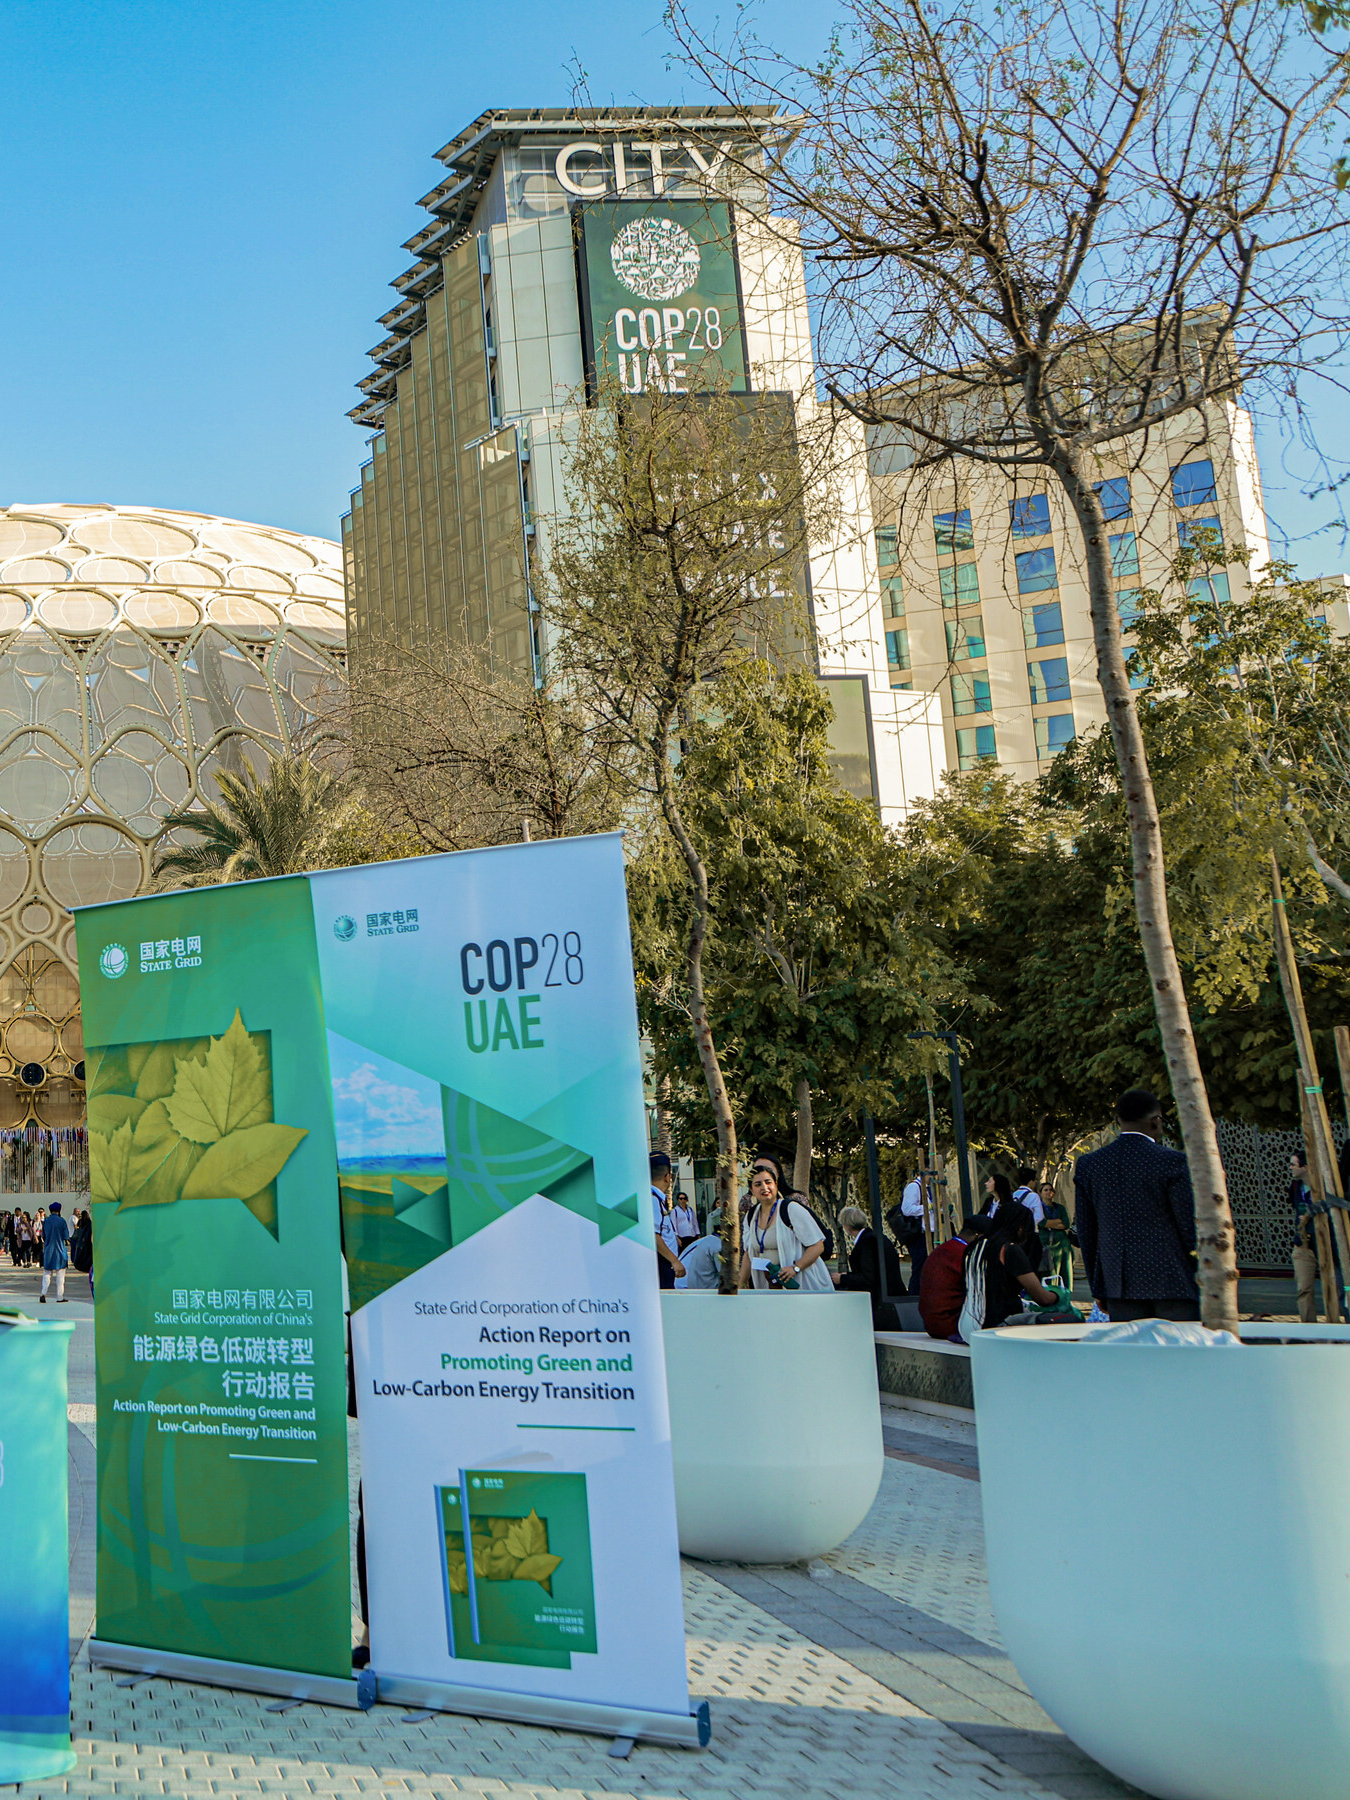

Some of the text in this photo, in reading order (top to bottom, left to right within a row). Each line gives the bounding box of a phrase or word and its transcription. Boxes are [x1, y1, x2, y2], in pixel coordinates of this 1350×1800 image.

[555, 140, 733, 197] CITY
[614, 306, 723, 351] COP28
[617, 352, 688, 394] UAE
[366, 909, 419, 928] 国家电网
[140, 935, 202, 961] 国家电网
[460, 931, 584, 996] COP28
[463, 994, 545, 1053] UAE
[172, 1288, 313, 1311] 国家电网有限公司
[414, 1299, 629, 1317] State Grid Corporation of China's
[154, 1311, 313, 1327] State Grid Corporation of China's
[479, 1326, 630, 1347] Action Report on
[133, 1335, 315, 1365] 能源绿色低碳转型
[440, 1353, 633, 1375] Promoting Green and
[222, 1369, 315, 1401] 行动报告
[373, 1379, 635, 1402] Low-Carbon Energy Transition
[113, 1399, 316, 1421] Action Report on Promoting Green and
[157, 1419, 317, 1440] Low-Carbon Energy Transition
